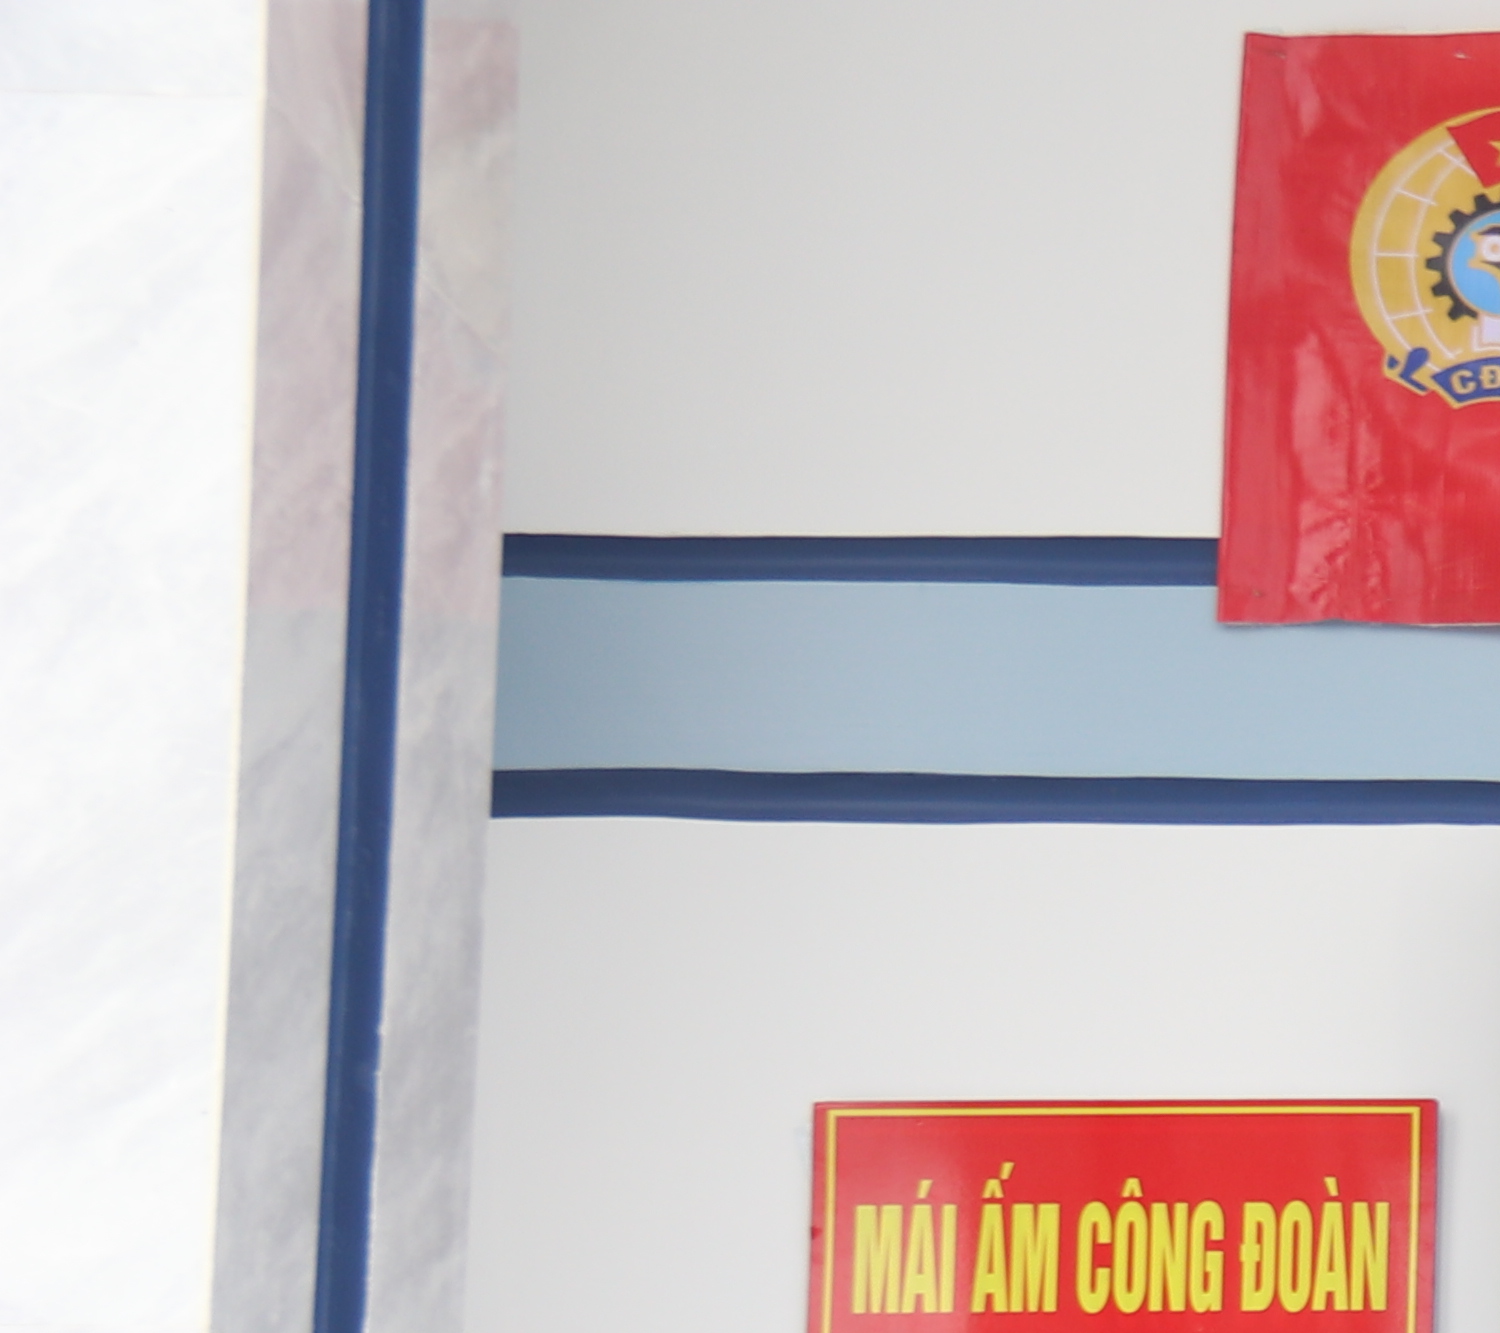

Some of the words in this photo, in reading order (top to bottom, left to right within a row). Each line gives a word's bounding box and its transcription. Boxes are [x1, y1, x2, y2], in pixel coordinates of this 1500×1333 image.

[850, 1177, 959, 1316] MÁI
[968, 1160, 1061, 1315] ẤM
[1075, 1176, 1226, 1315] CÔNG
[1238, 1175, 1390, 1313] ĐOÀN
